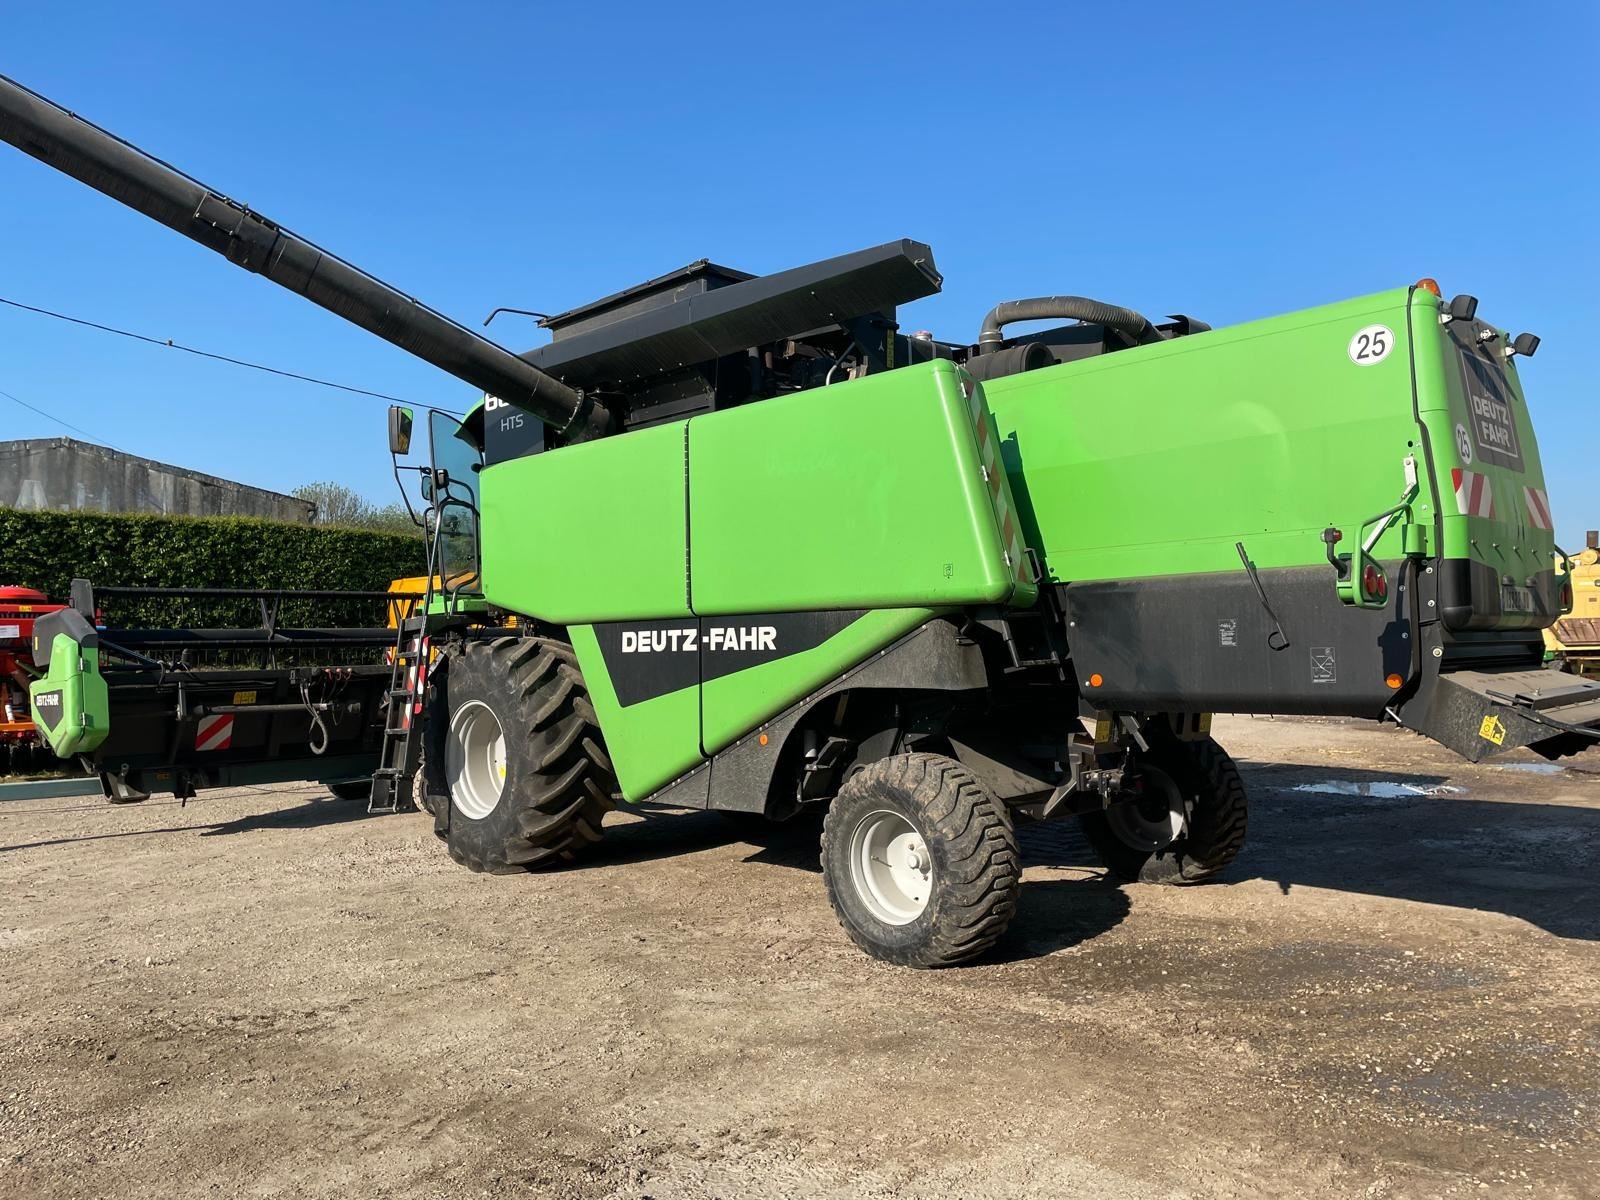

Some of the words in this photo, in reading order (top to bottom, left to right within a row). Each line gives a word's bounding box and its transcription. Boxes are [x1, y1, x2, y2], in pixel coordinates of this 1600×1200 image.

[1357, 331, 1385, 359] 25
[501, 413, 524, 432] HTS
[1472, 395, 1508, 425] DEUTZ
[1457, 429, 1470, 459] 25
[1481, 420, 1511, 448] FAHR
[621, 626, 777, 653] DEUTZ-FAHR
